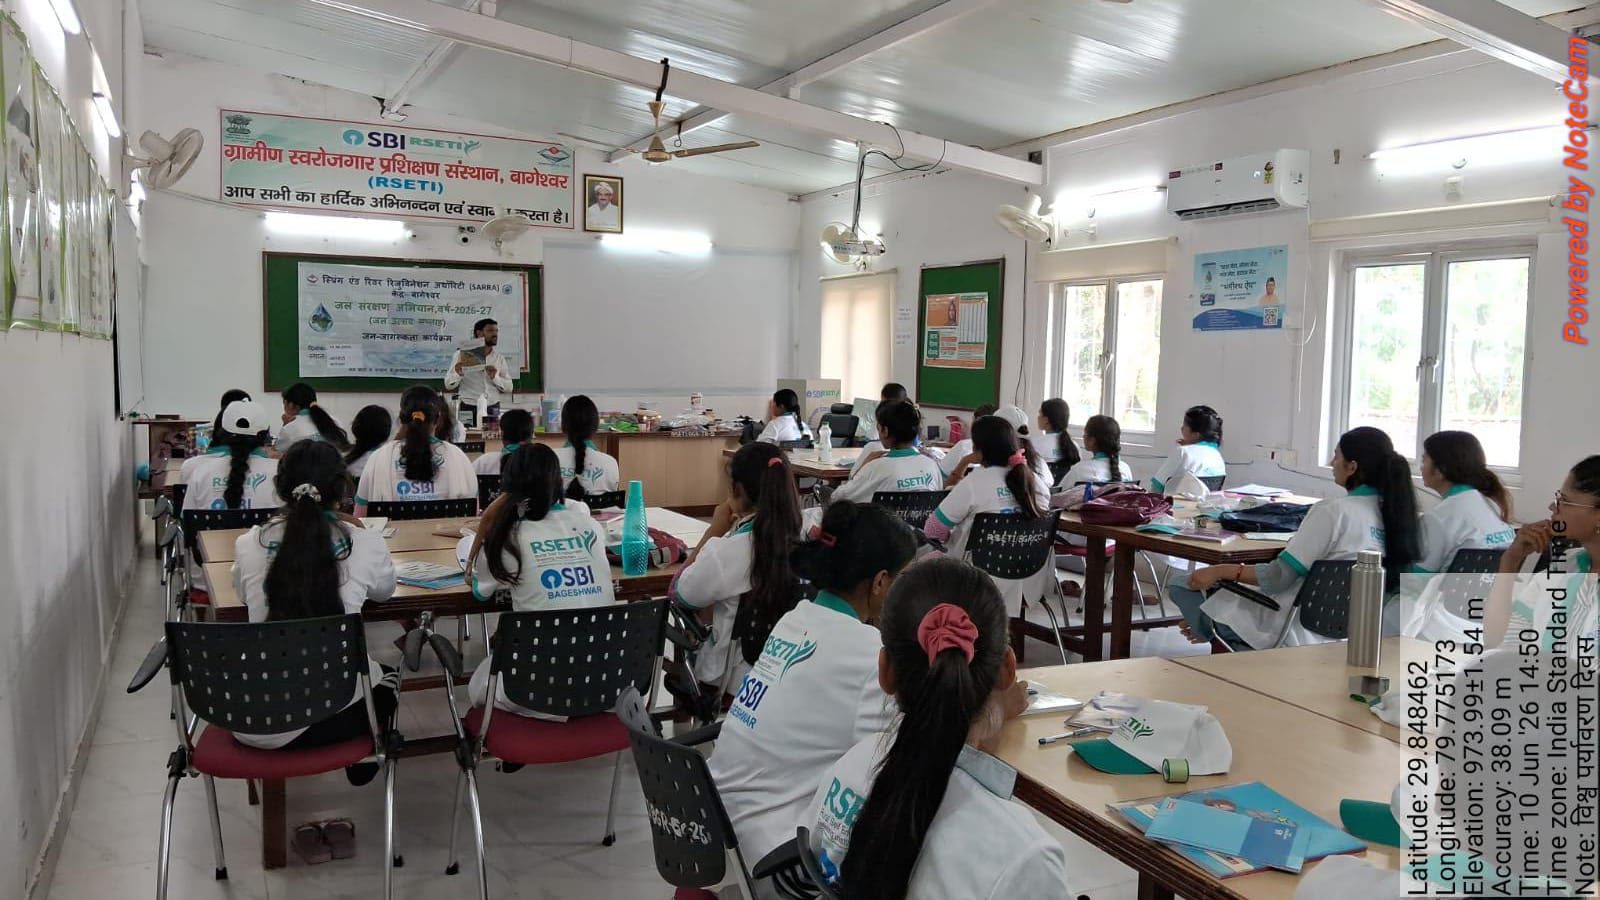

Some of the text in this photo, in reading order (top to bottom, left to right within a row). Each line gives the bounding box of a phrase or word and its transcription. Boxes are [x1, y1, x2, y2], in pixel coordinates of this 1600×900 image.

[368, 132, 462, 150] SBI RSETI
[224, 141, 569, 189] ग्रामीण स्वरोजगार प्रशिक्षण संस्थान, बागेश्वर
[368, 176, 444, 194] (RSETI)
[224, 186, 256, 199] आप
[259, 186, 291, 201] सभी
[296, 191, 315, 203] का
[320, 190, 365, 206] हार्दिक
[369, 194, 440, 212] अभिनन्दन
[444, 201, 466, 215] एवं
[560, 467, 591, 477] RSTI
[212, 477, 251, 487] RSI
[411, 481, 434, 494] SBI
[896, 477, 924, 488] RSETI
[530, 536, 583, 554] RSETI
[561, 565, 595, 587] SBI
[547, 586, 602, 600] BAGESHWAR
[739, 678, 768, 711] SBI
[824, 776, 866, 827] RSE
